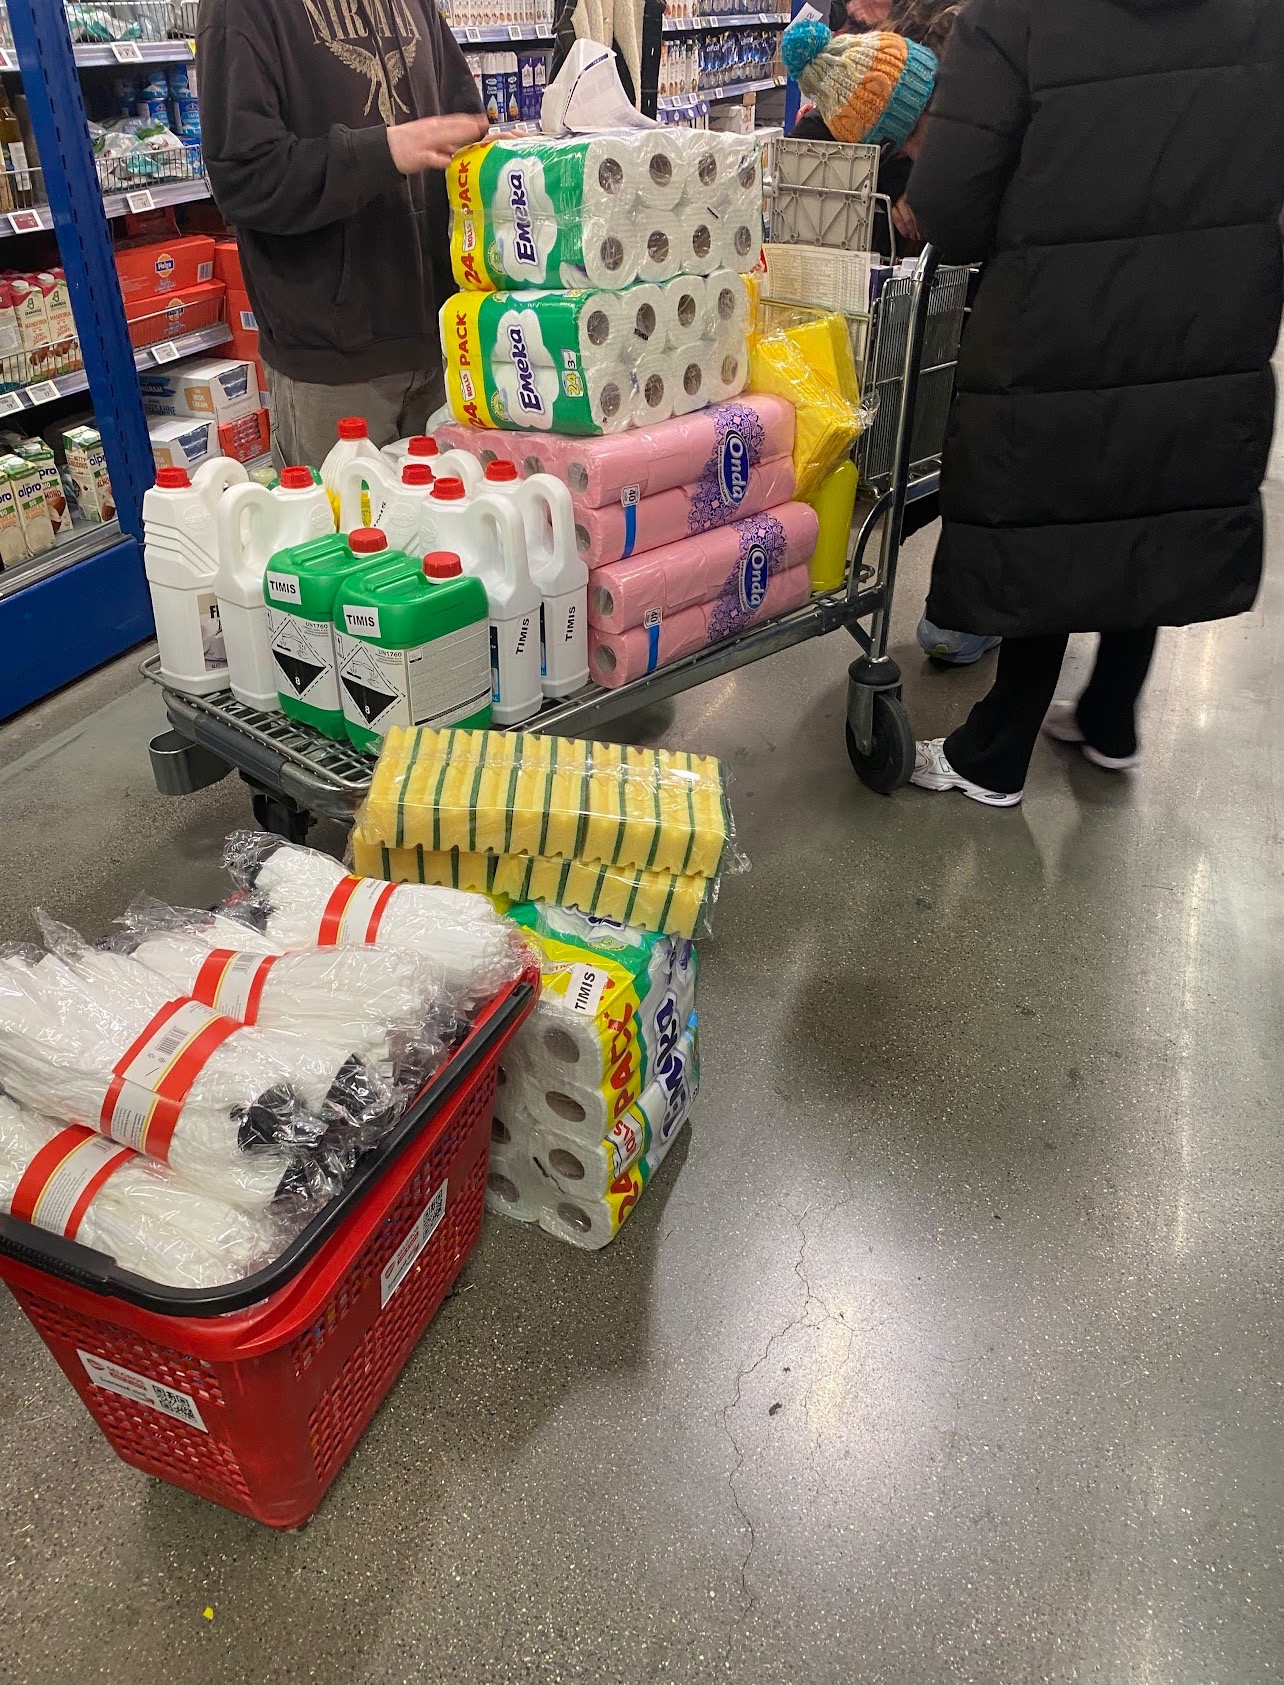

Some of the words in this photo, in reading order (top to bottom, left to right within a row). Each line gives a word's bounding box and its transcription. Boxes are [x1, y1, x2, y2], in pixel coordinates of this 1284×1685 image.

[457, 158, 474, 216] PACK
[509, 172, 537, 263] Emeka
[461, 252, 482, 284] 24
[456, 312, 471, 366] PACK
[509, 328, 542, 411] Emeka
[462, 373, 473, 397] ROLLS
[463, 402, 489, 430] 24
[729, 437, 747, 499] Onda
[18, 483, 42, 498] alpro
[628, 489, 636, 502] 40
[269, 580, 296, 594] TIMIS
[750, 550, 765, 606] Onda
[346, 614, 375, 627] TIMIS
[565, 606, 576, 642] TIMIS
[650, 611, 659, 623] 40
[515, 617, 530, 655] TIMIS
[378, 649, 402, 658] UN1760
[294, 676, 301, 686] 8
[364, 705, 371, 715] 8
[574, 971, 596, 1010] TIMIS
